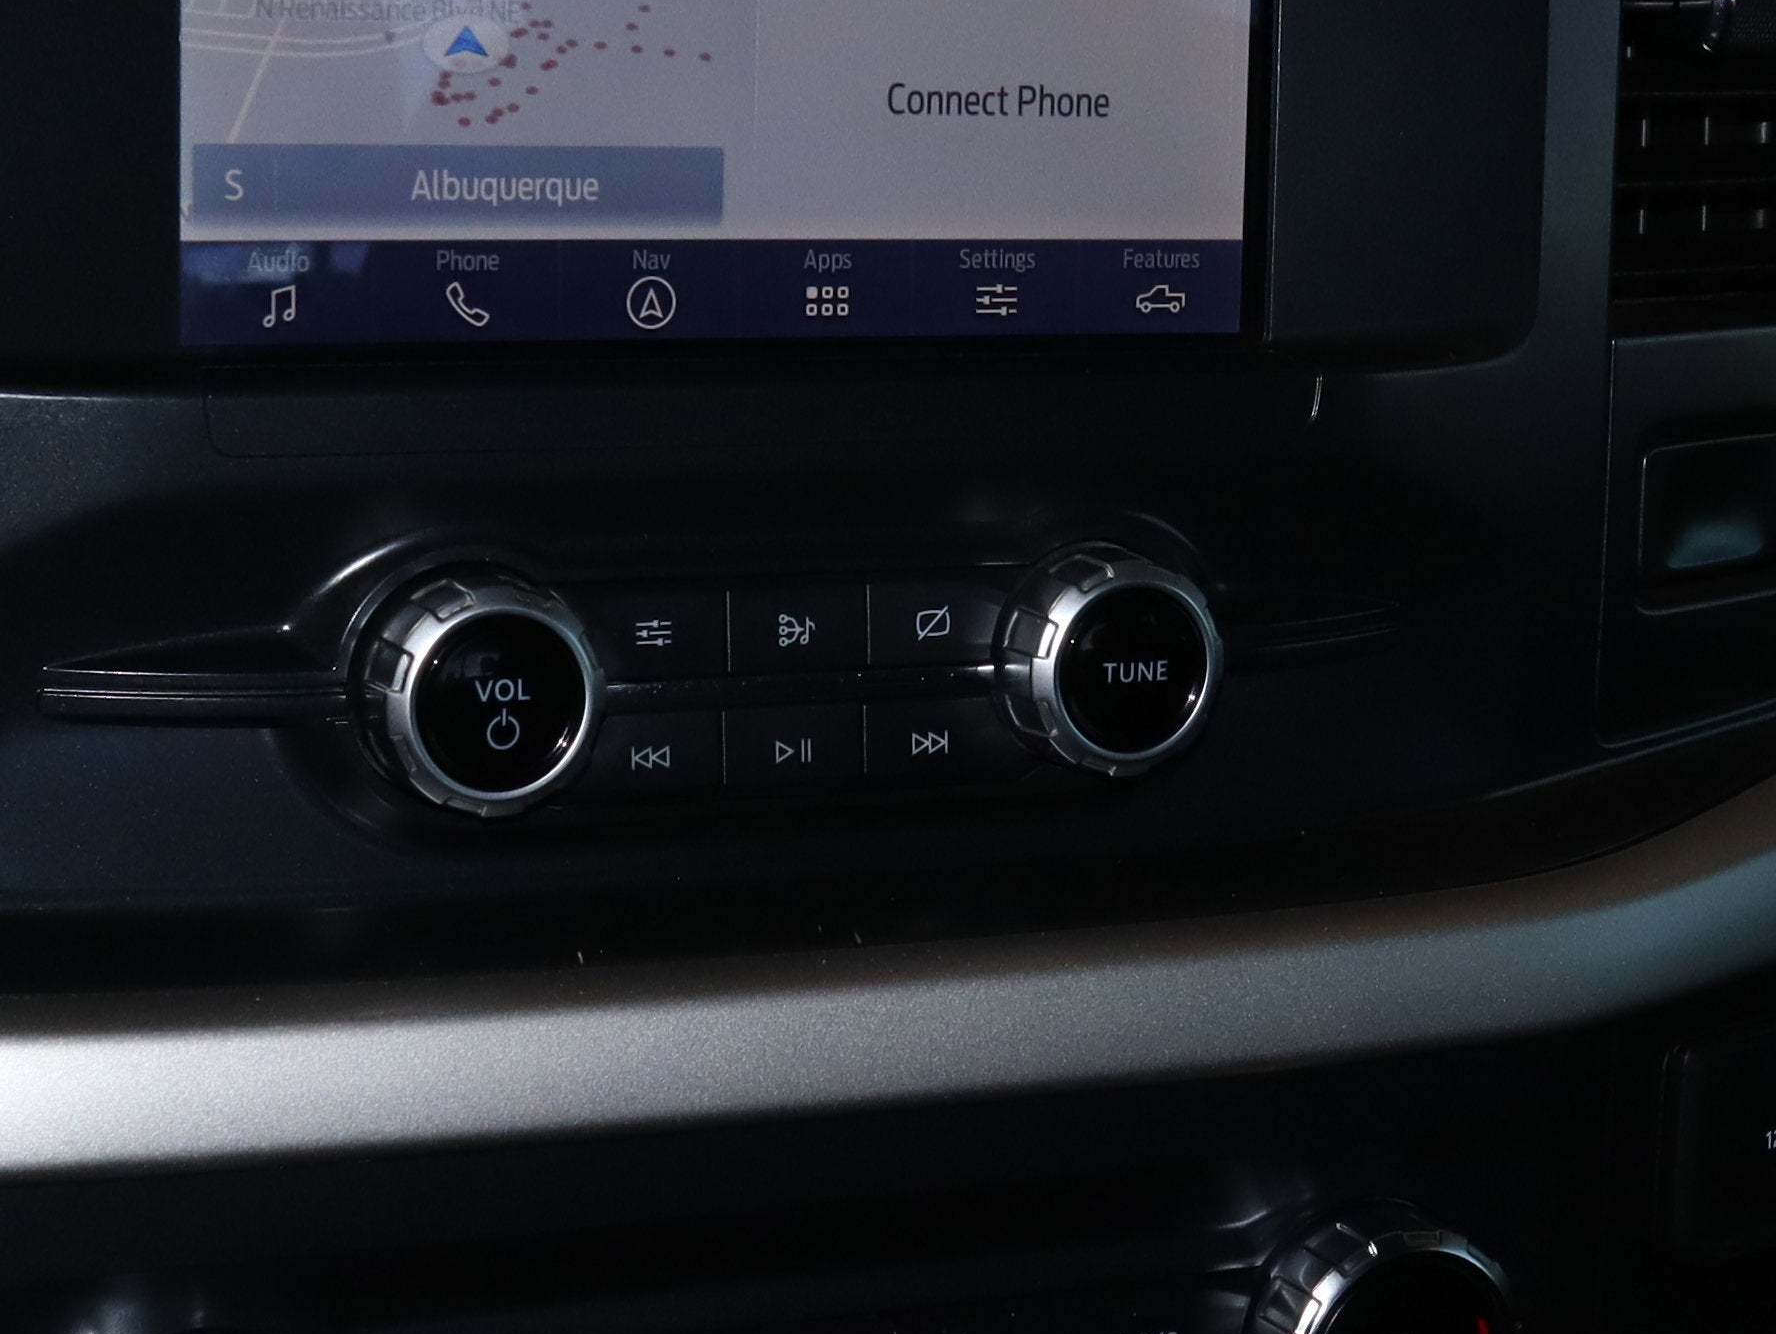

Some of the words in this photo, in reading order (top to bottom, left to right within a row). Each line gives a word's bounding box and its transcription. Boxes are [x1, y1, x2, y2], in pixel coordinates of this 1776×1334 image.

[887, 83, 1009, 118] Connect
[1017, 84, 1111, 119] Phone
[224, 168, 245, 202] S
[411, 169, 600, 208] Albuquerque
[246, 249, 311, 274] Audio
[436, 249, 500, 273] Phone
[632, 249, 672, 272] Nav
[804, 248, 853, 274] Apps
[958, 248, 1036, 274] Settings
[1123, 249, 1200, 271] Features
[1102, 660, 1170, 684] TUNE
[473, 678, 532, 703] VOL
